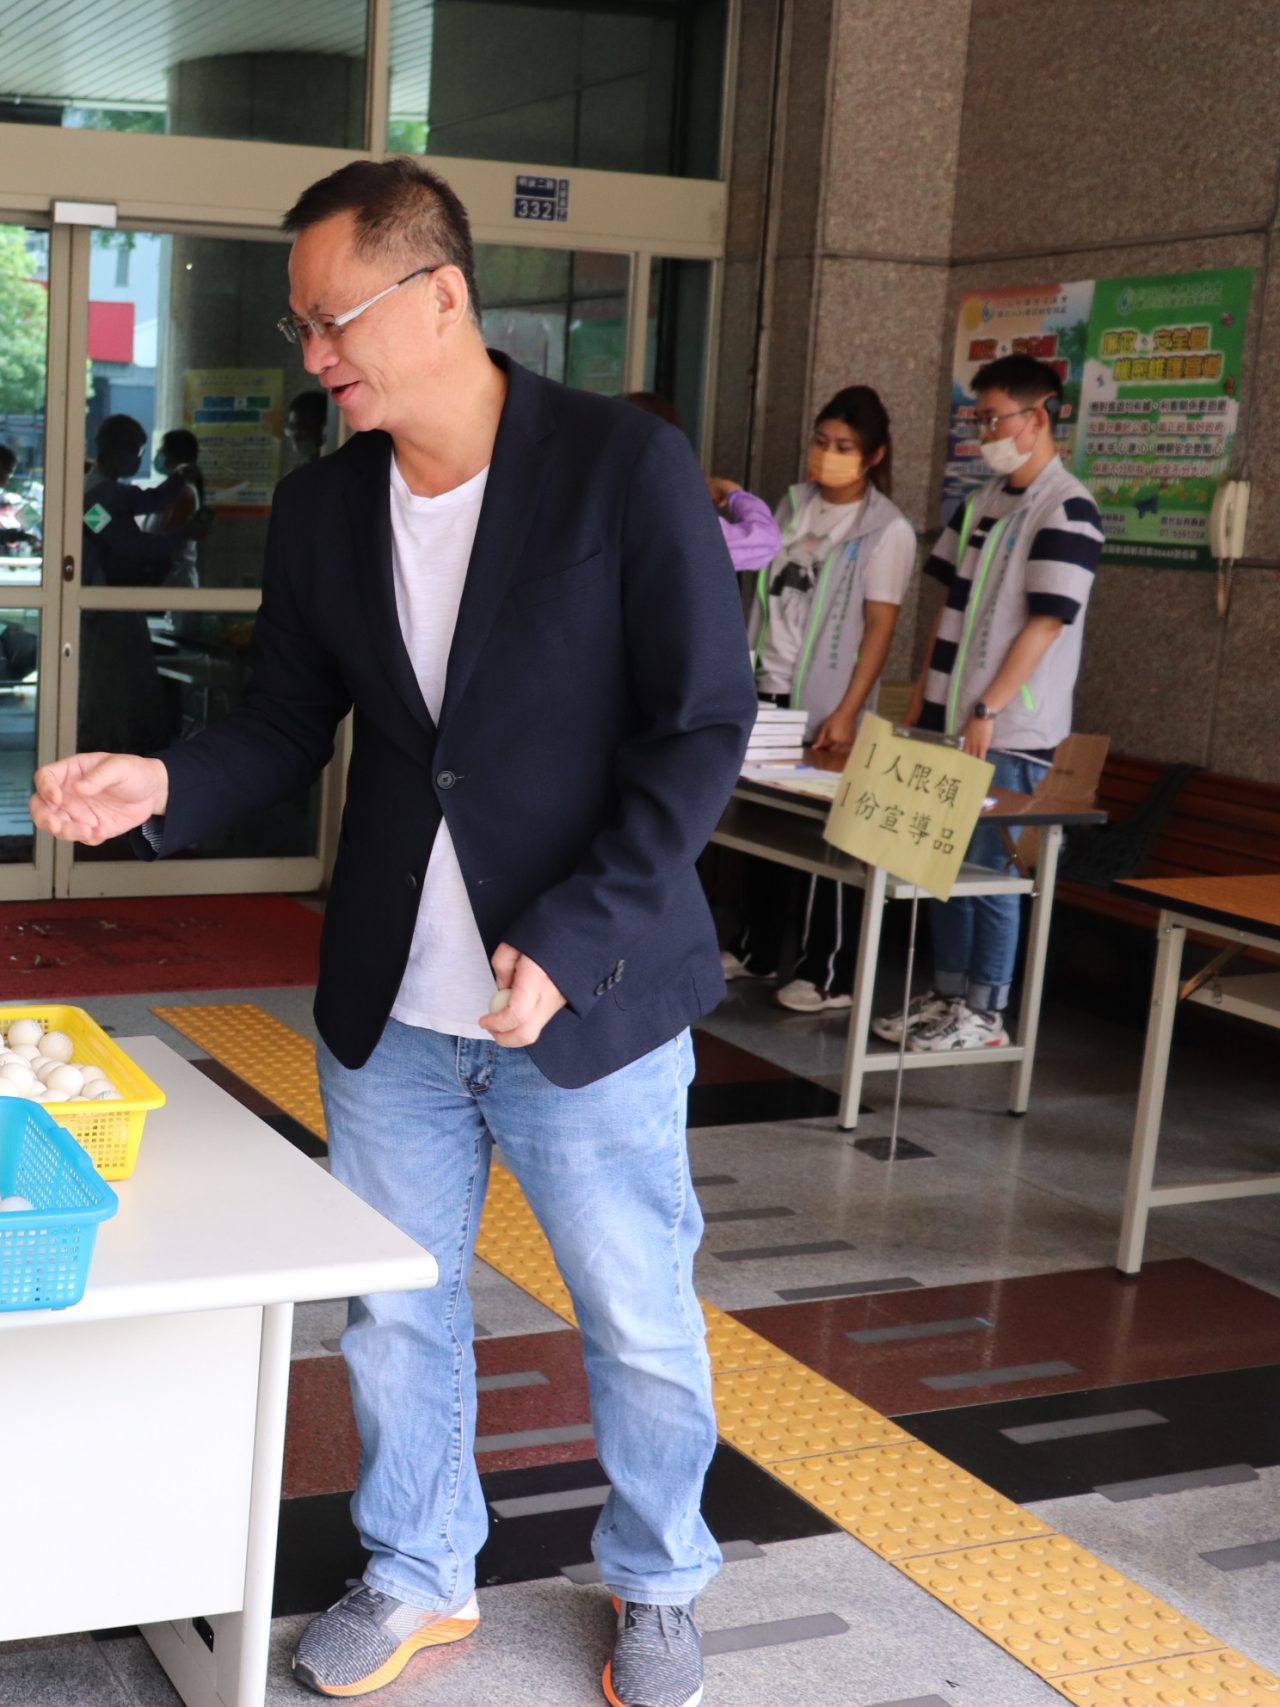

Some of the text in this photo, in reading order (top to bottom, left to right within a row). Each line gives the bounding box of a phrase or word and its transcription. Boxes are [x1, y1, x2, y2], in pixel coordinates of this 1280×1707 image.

[518, 200, 553, 219] 332
[864, 743, 962, 808] 1人限領
[839, 782, 955, 855] 1份宣導品
